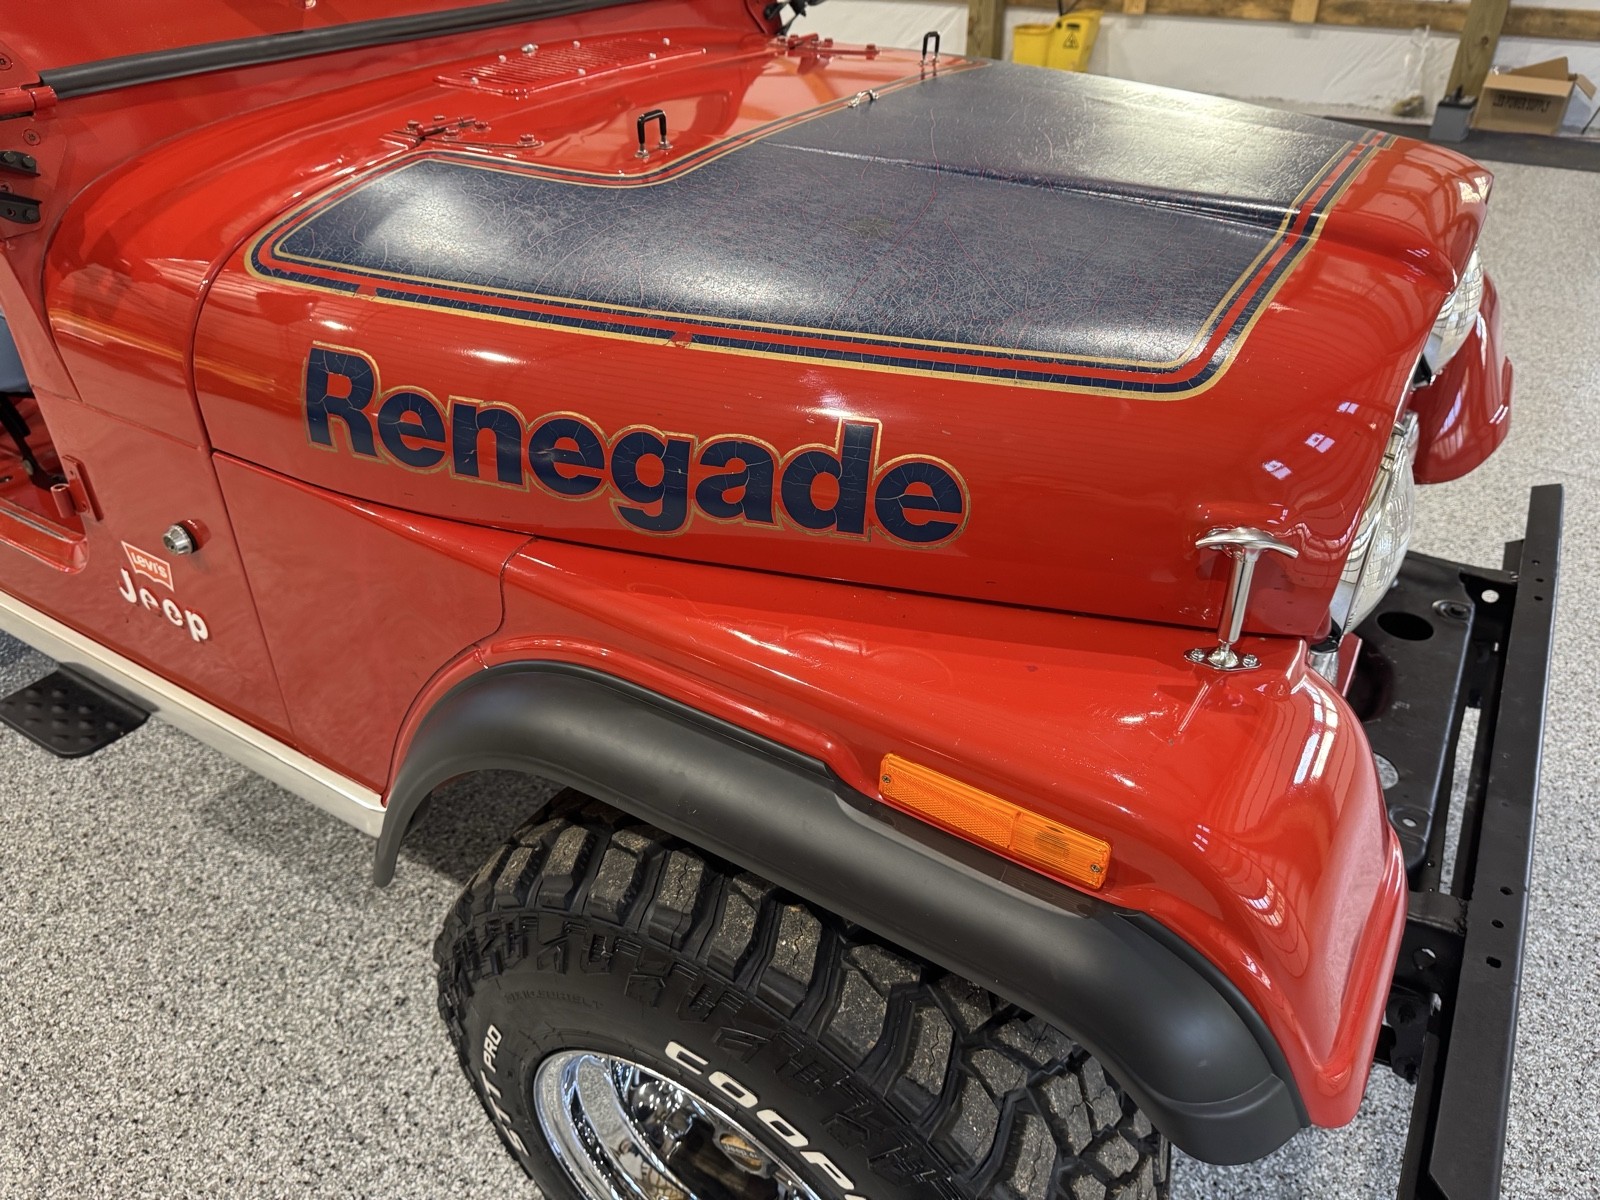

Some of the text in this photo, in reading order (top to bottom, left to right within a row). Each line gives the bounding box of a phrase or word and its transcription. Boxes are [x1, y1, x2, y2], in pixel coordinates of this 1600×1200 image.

[305, 342, 969, 548] Renegade
[119, 568, 209, 642] Jeep
[480, 1024, 530, 1157] STT PRO
[664, 1041, 867, 1200] COOP
